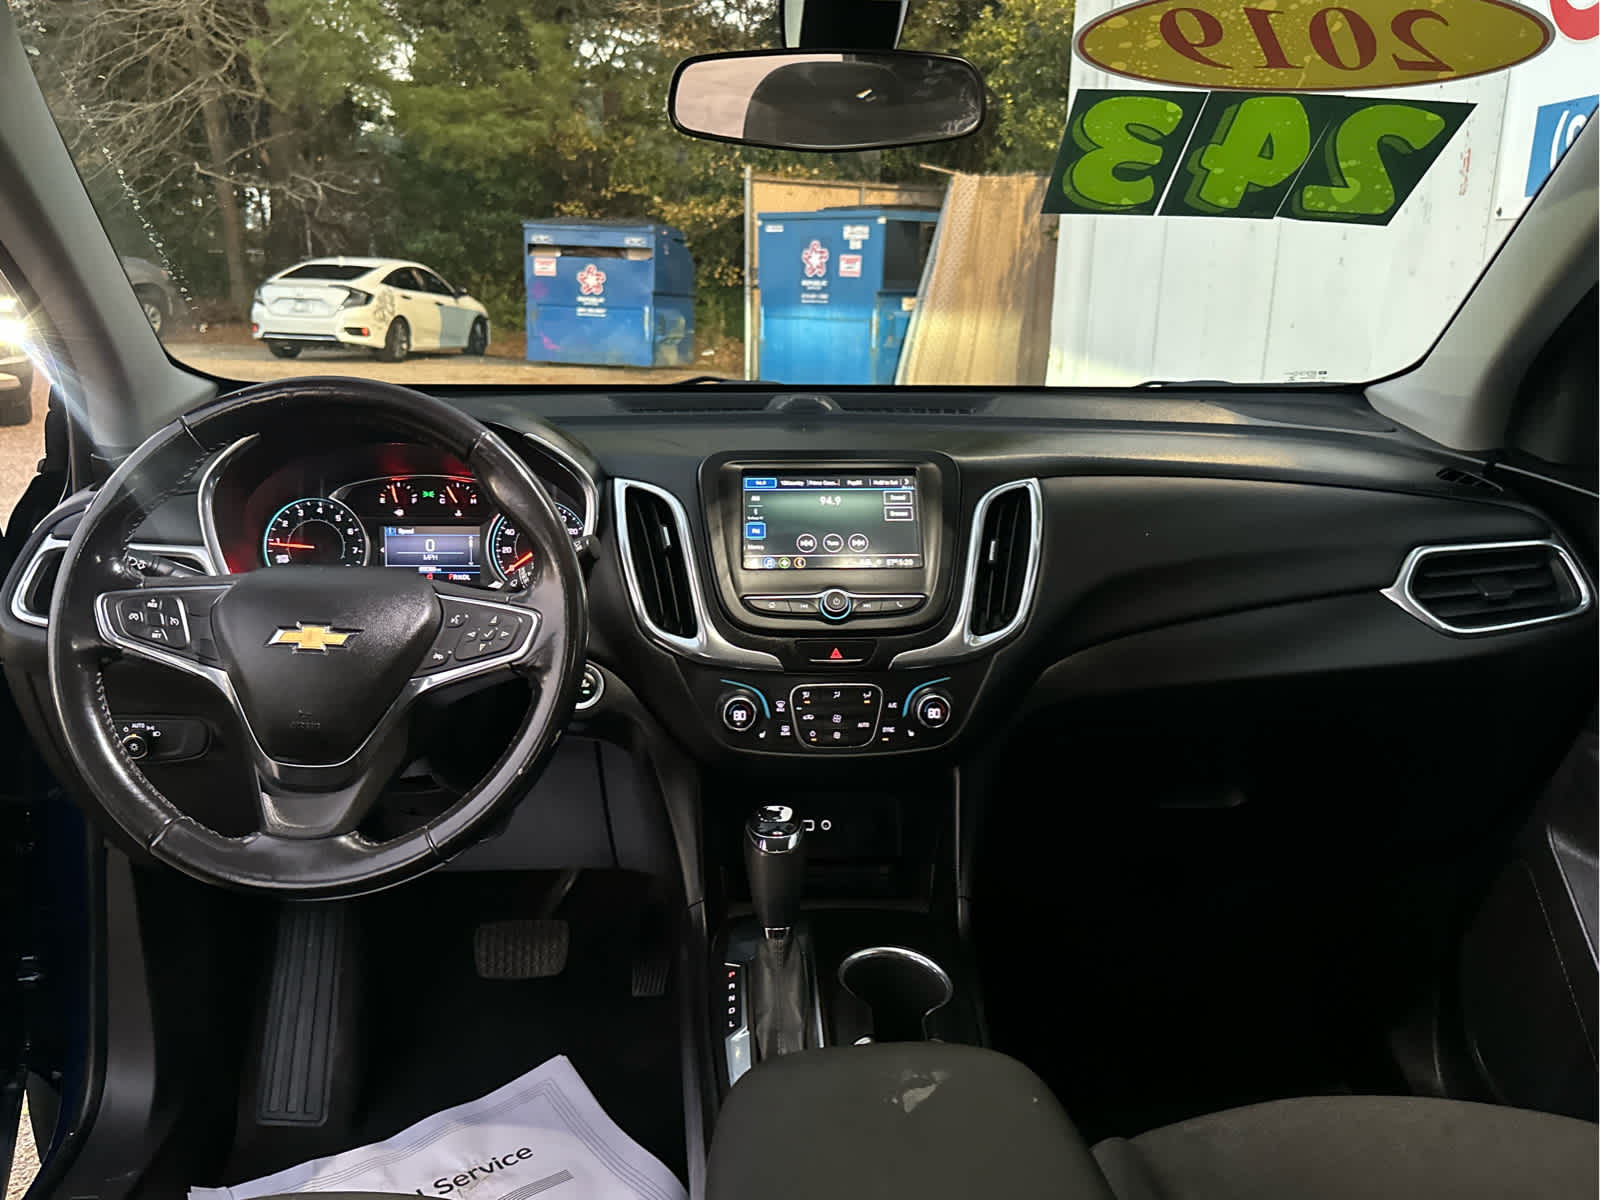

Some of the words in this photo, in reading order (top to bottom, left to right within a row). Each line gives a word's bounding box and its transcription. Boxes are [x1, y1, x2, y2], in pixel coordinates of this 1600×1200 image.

[819, 495, 841, 506] 94.9
[335, 514, 342, 522] 5
[352, 546, 359, 554] 7
[425, 538, 435, 552] 0
[733, 709, 747, 721] 80
[927, 707, 941, 719] 80
[433, 1146, 534, 1195] Service
